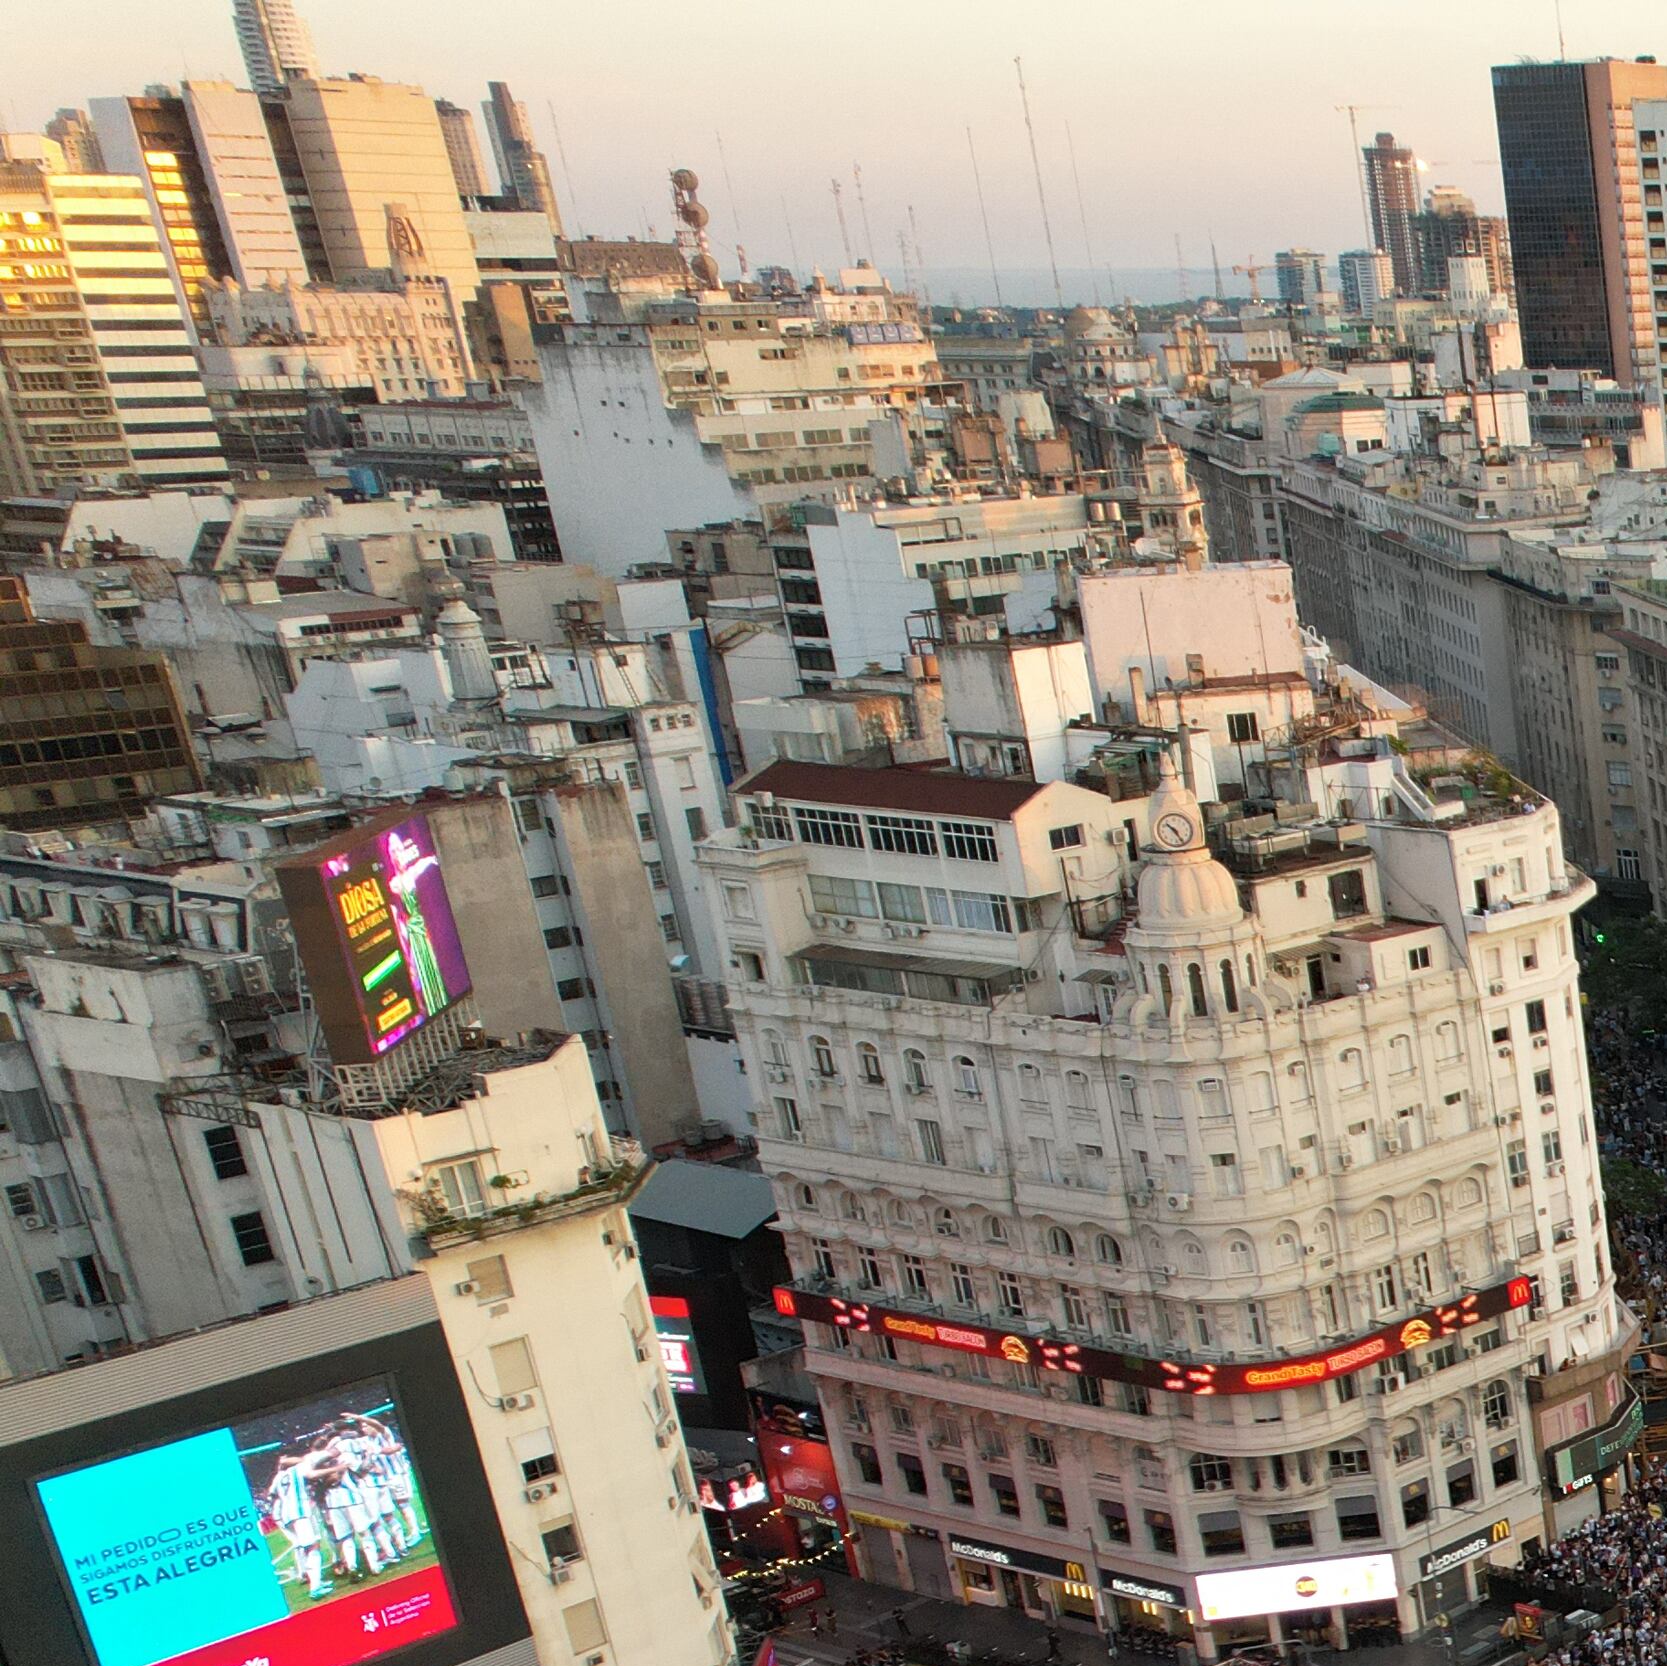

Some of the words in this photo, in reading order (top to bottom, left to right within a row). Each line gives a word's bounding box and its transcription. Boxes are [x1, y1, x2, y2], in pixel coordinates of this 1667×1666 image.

[1247, 1368, 1289, 1385] Grand
[1289, 1362, 1325, 1383] Tasty
[74, 1554, 97, 1570] MI
[186, 1519, 208, 1535] ES
[212, 1505, 249, 1526] QUE
[80, 1555, 148, 1585] SIGAMOS
[152, 1522, 254, 1562] DISFRUTANDO
[952, 1542, 1009, 1565] McDonald's
[1426, 1537, 1488, 1574] McDonald's
[87, 1573, 152, 1606] ESTA
[155, 1537, 260, 1585] ALEGRÍA
[1112, 1579, 1175, 1603] McDonald's
